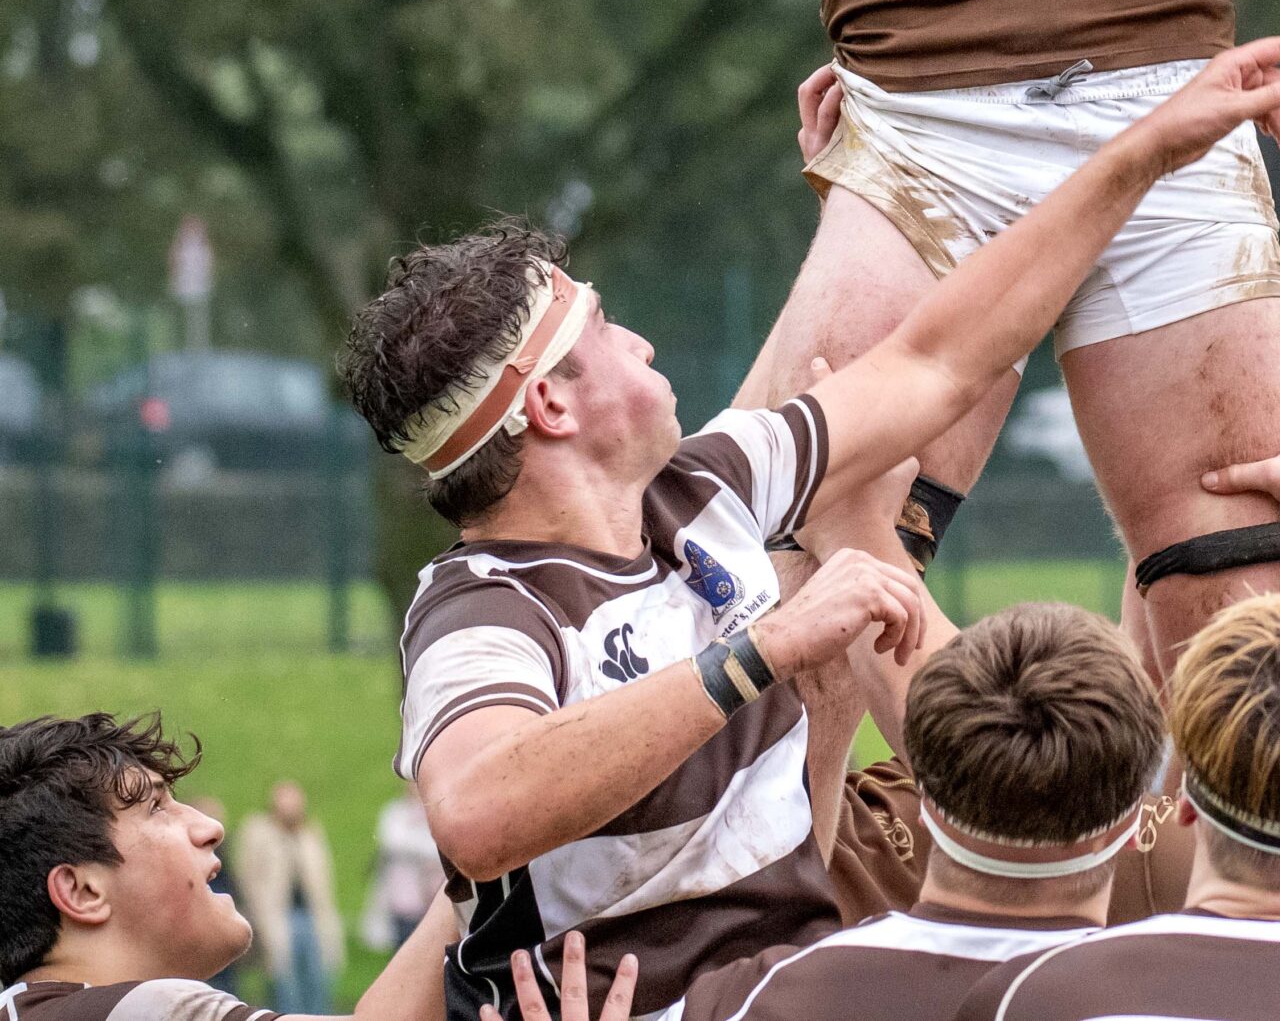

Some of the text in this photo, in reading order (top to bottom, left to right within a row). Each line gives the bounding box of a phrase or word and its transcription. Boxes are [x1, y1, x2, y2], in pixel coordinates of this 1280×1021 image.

[720, 613, 749, 638] eter's,
[744, 599, 761, 614] York
[756, 589, 771, 604] RFC
